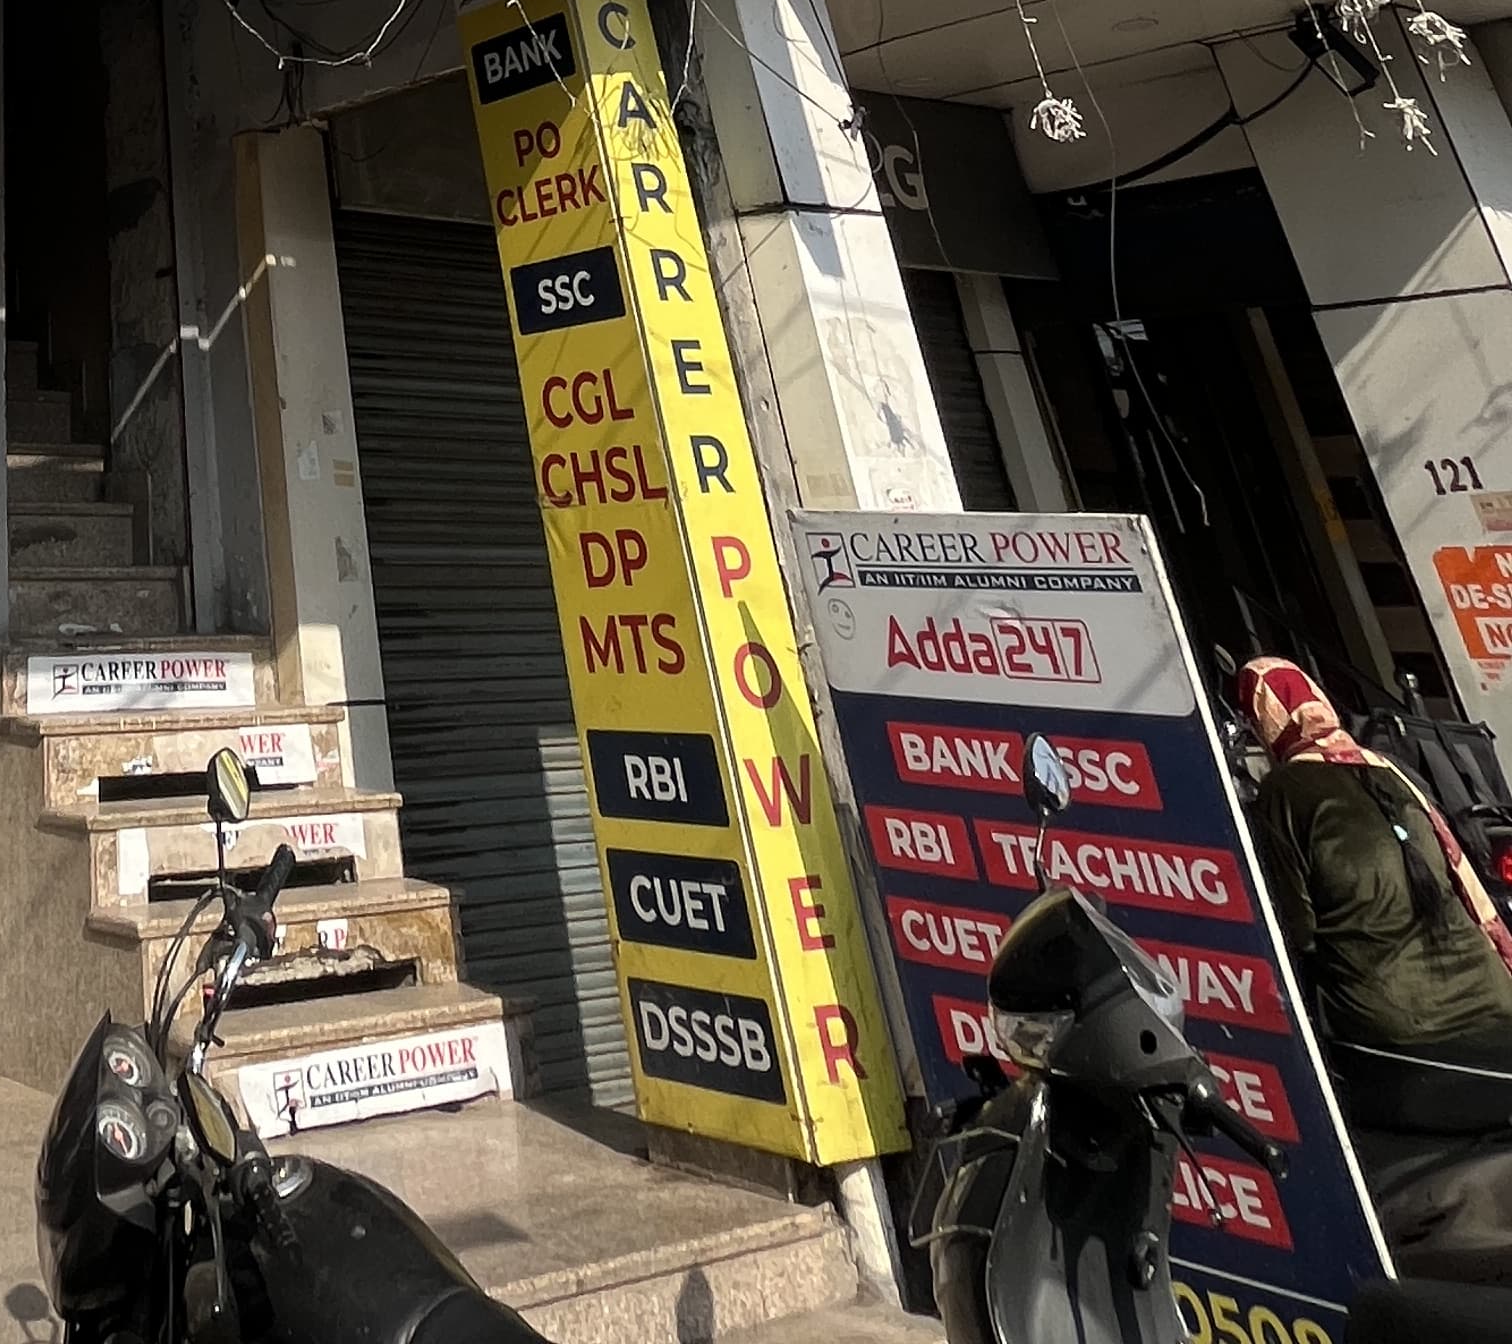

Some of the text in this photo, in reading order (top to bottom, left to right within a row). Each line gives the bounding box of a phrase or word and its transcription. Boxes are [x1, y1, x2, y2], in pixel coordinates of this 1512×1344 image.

[483, 30, 561, 85] BANK
[514, 121, 561, 167] PO
[496, 164, 606, 228] CLERK
[538, 271, 595, 315] SSC
[542, 370, 634, 428] CGL
[541, 446, 669, 506] CHSL
[1424, 456, 1484, 496] 121
[579, 530, 648, 587] DP
[849, 531, 1131, 565] CAREER POWER
[863, 572, 1136, 592] AN IIT/IIM ALUMNI COMPANY
[81, 658, 227, 682] CAREER POWER
[579, 614, 686, 675] MTS
[887, 615, 1102, 683] Adda247
[240, 733, 284, 754] WER
[898, 731, 1021, 784] BANK
[624, 754, 688, 802] RBI
[1057, 747, 1141, 796] SSC
[885, 817, 956, 865] RBI
[991, 831, 1228, 906] TEACHING
[629, 874, 727, 933] CUET
[901, 909, 1003, 959] CUET
[639, 1000, 772, 1071] DSSSB
[306, 1053, 396, 1090] CAREER
[398, 1037, 476, 1074] POWER
